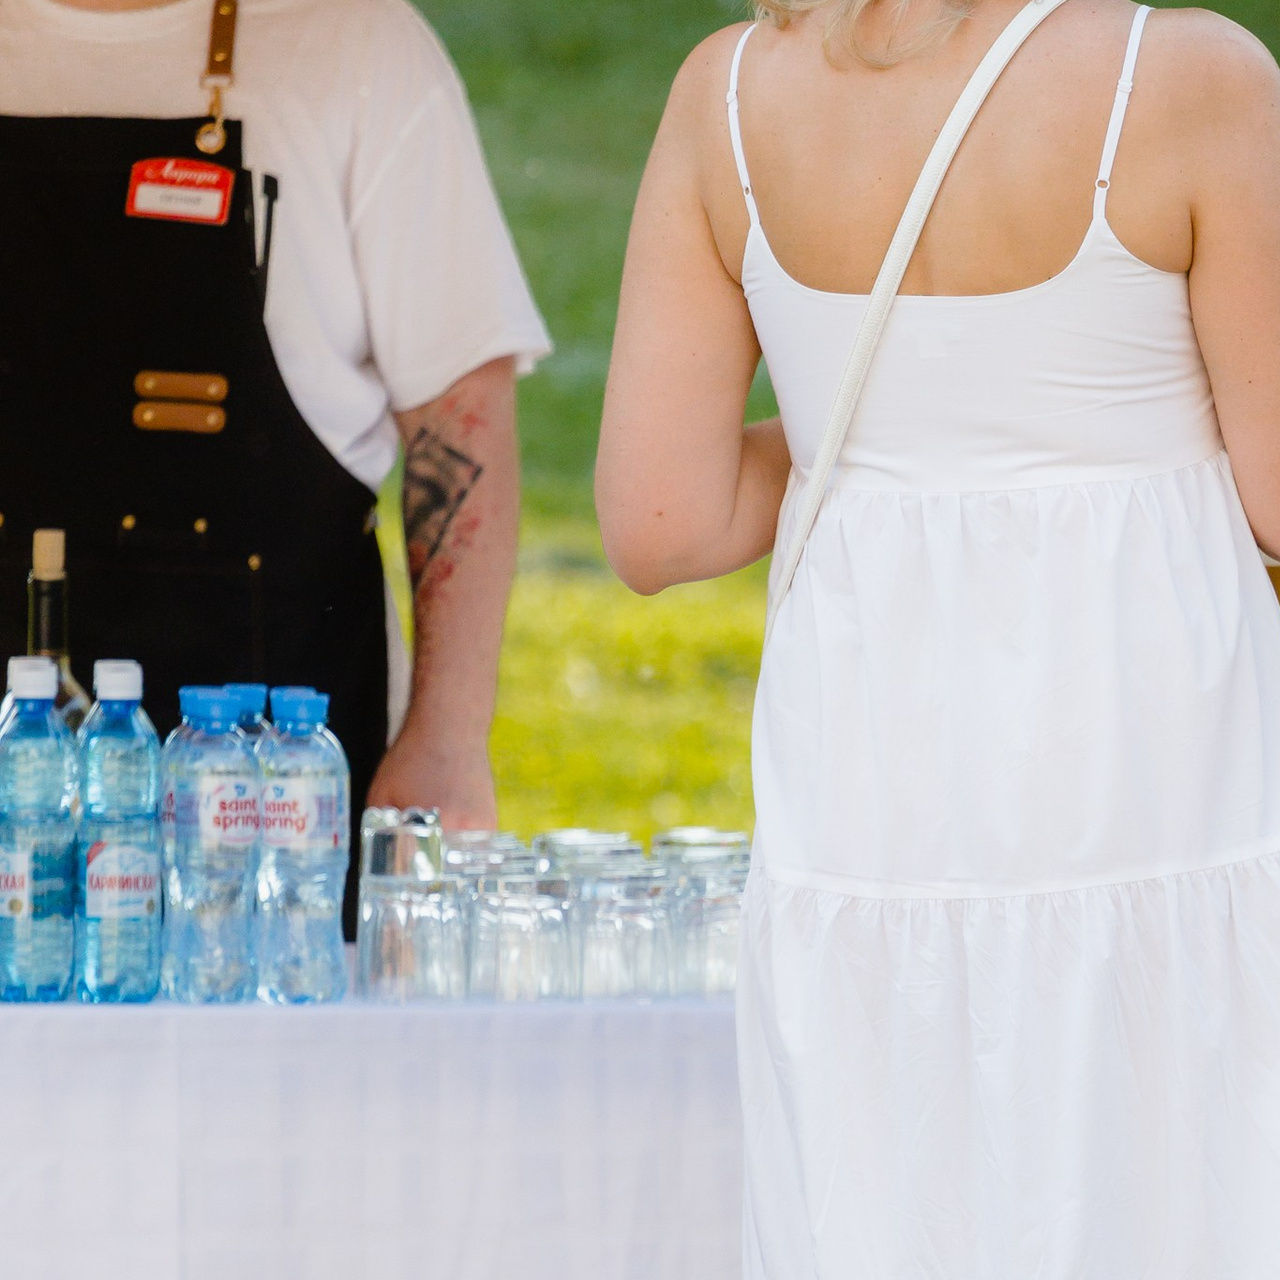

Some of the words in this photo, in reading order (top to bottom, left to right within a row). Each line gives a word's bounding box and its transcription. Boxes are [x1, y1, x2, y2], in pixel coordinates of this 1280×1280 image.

[219, 799, 258, 812] saint
[263, 800, 299, 813] aint
[263, 814, 307, 833] pring
